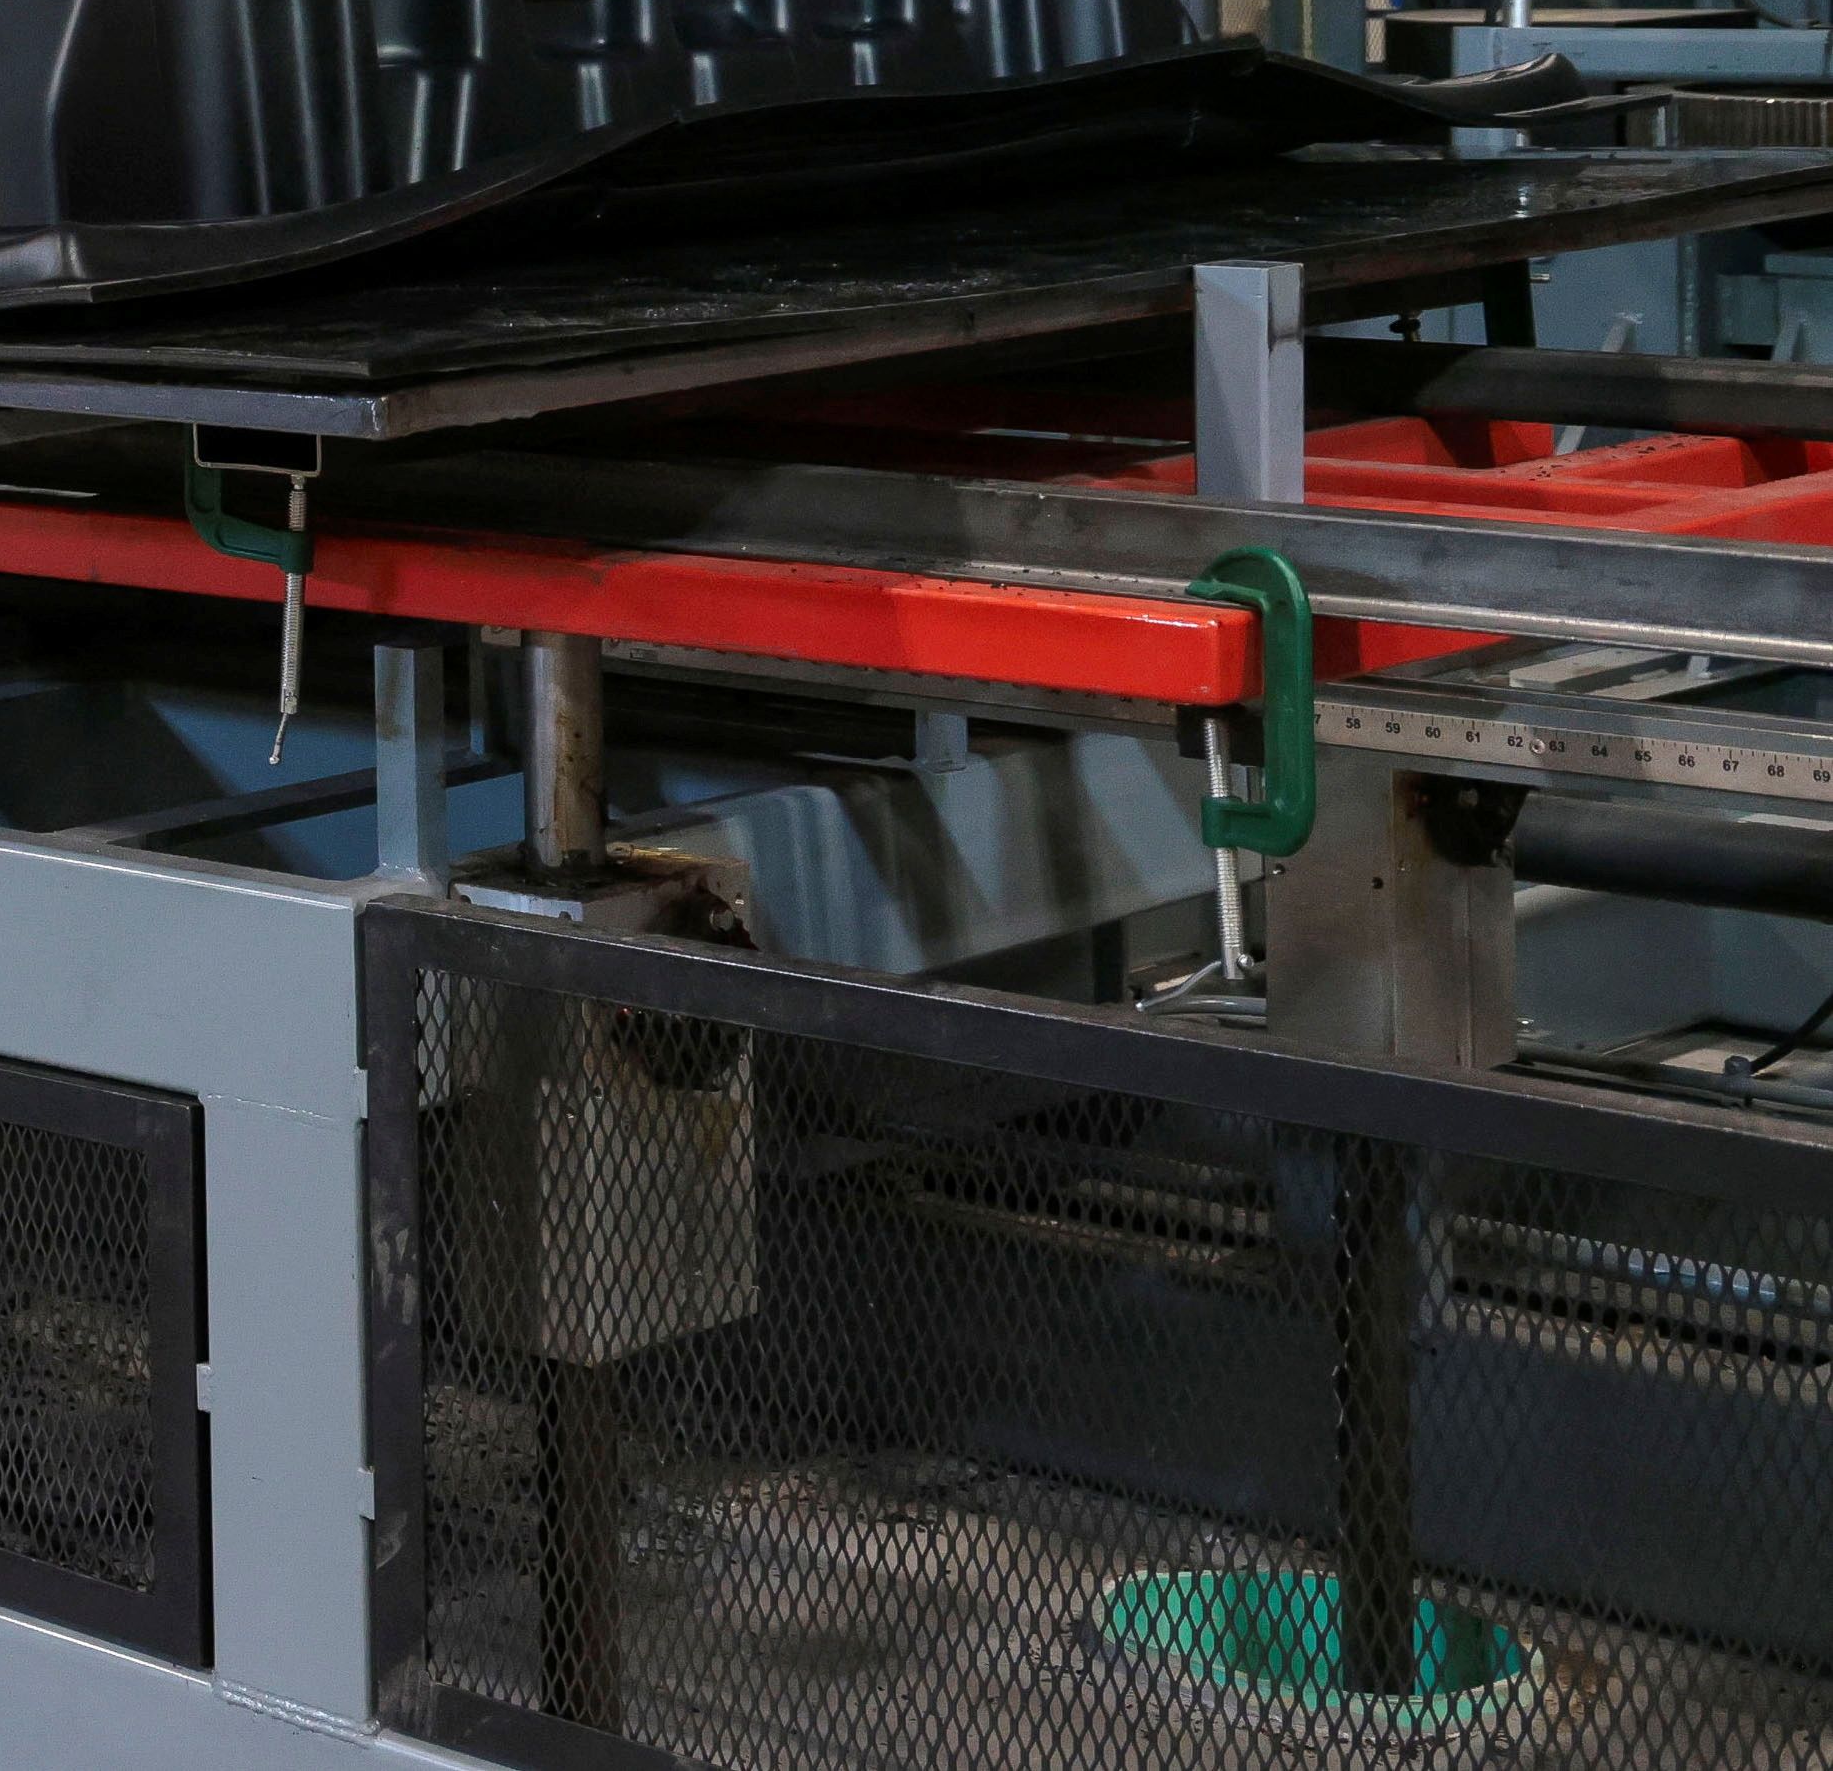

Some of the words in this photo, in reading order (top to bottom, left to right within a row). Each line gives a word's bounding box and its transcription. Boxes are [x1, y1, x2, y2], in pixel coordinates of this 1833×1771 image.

[1346, 718, 1361, 730] 58
[1385, 722, 1401, 734] 59
[1425, 727, 1441, 739] 60
[1466, 731, 1481, 743] 61
[1507, 736, 1523, 748] 62
[1549, 741, 1565, 752] 63
[1591, 746, 1608, 758] 64
[1634, 750, 1652, 762] 65
[1678, 755, 1695, 768] 66
[1722, 759, 1739, 772] 67
[1767, 765, 1785, 777] 68
[1813, 770, 1831, 782] 69
